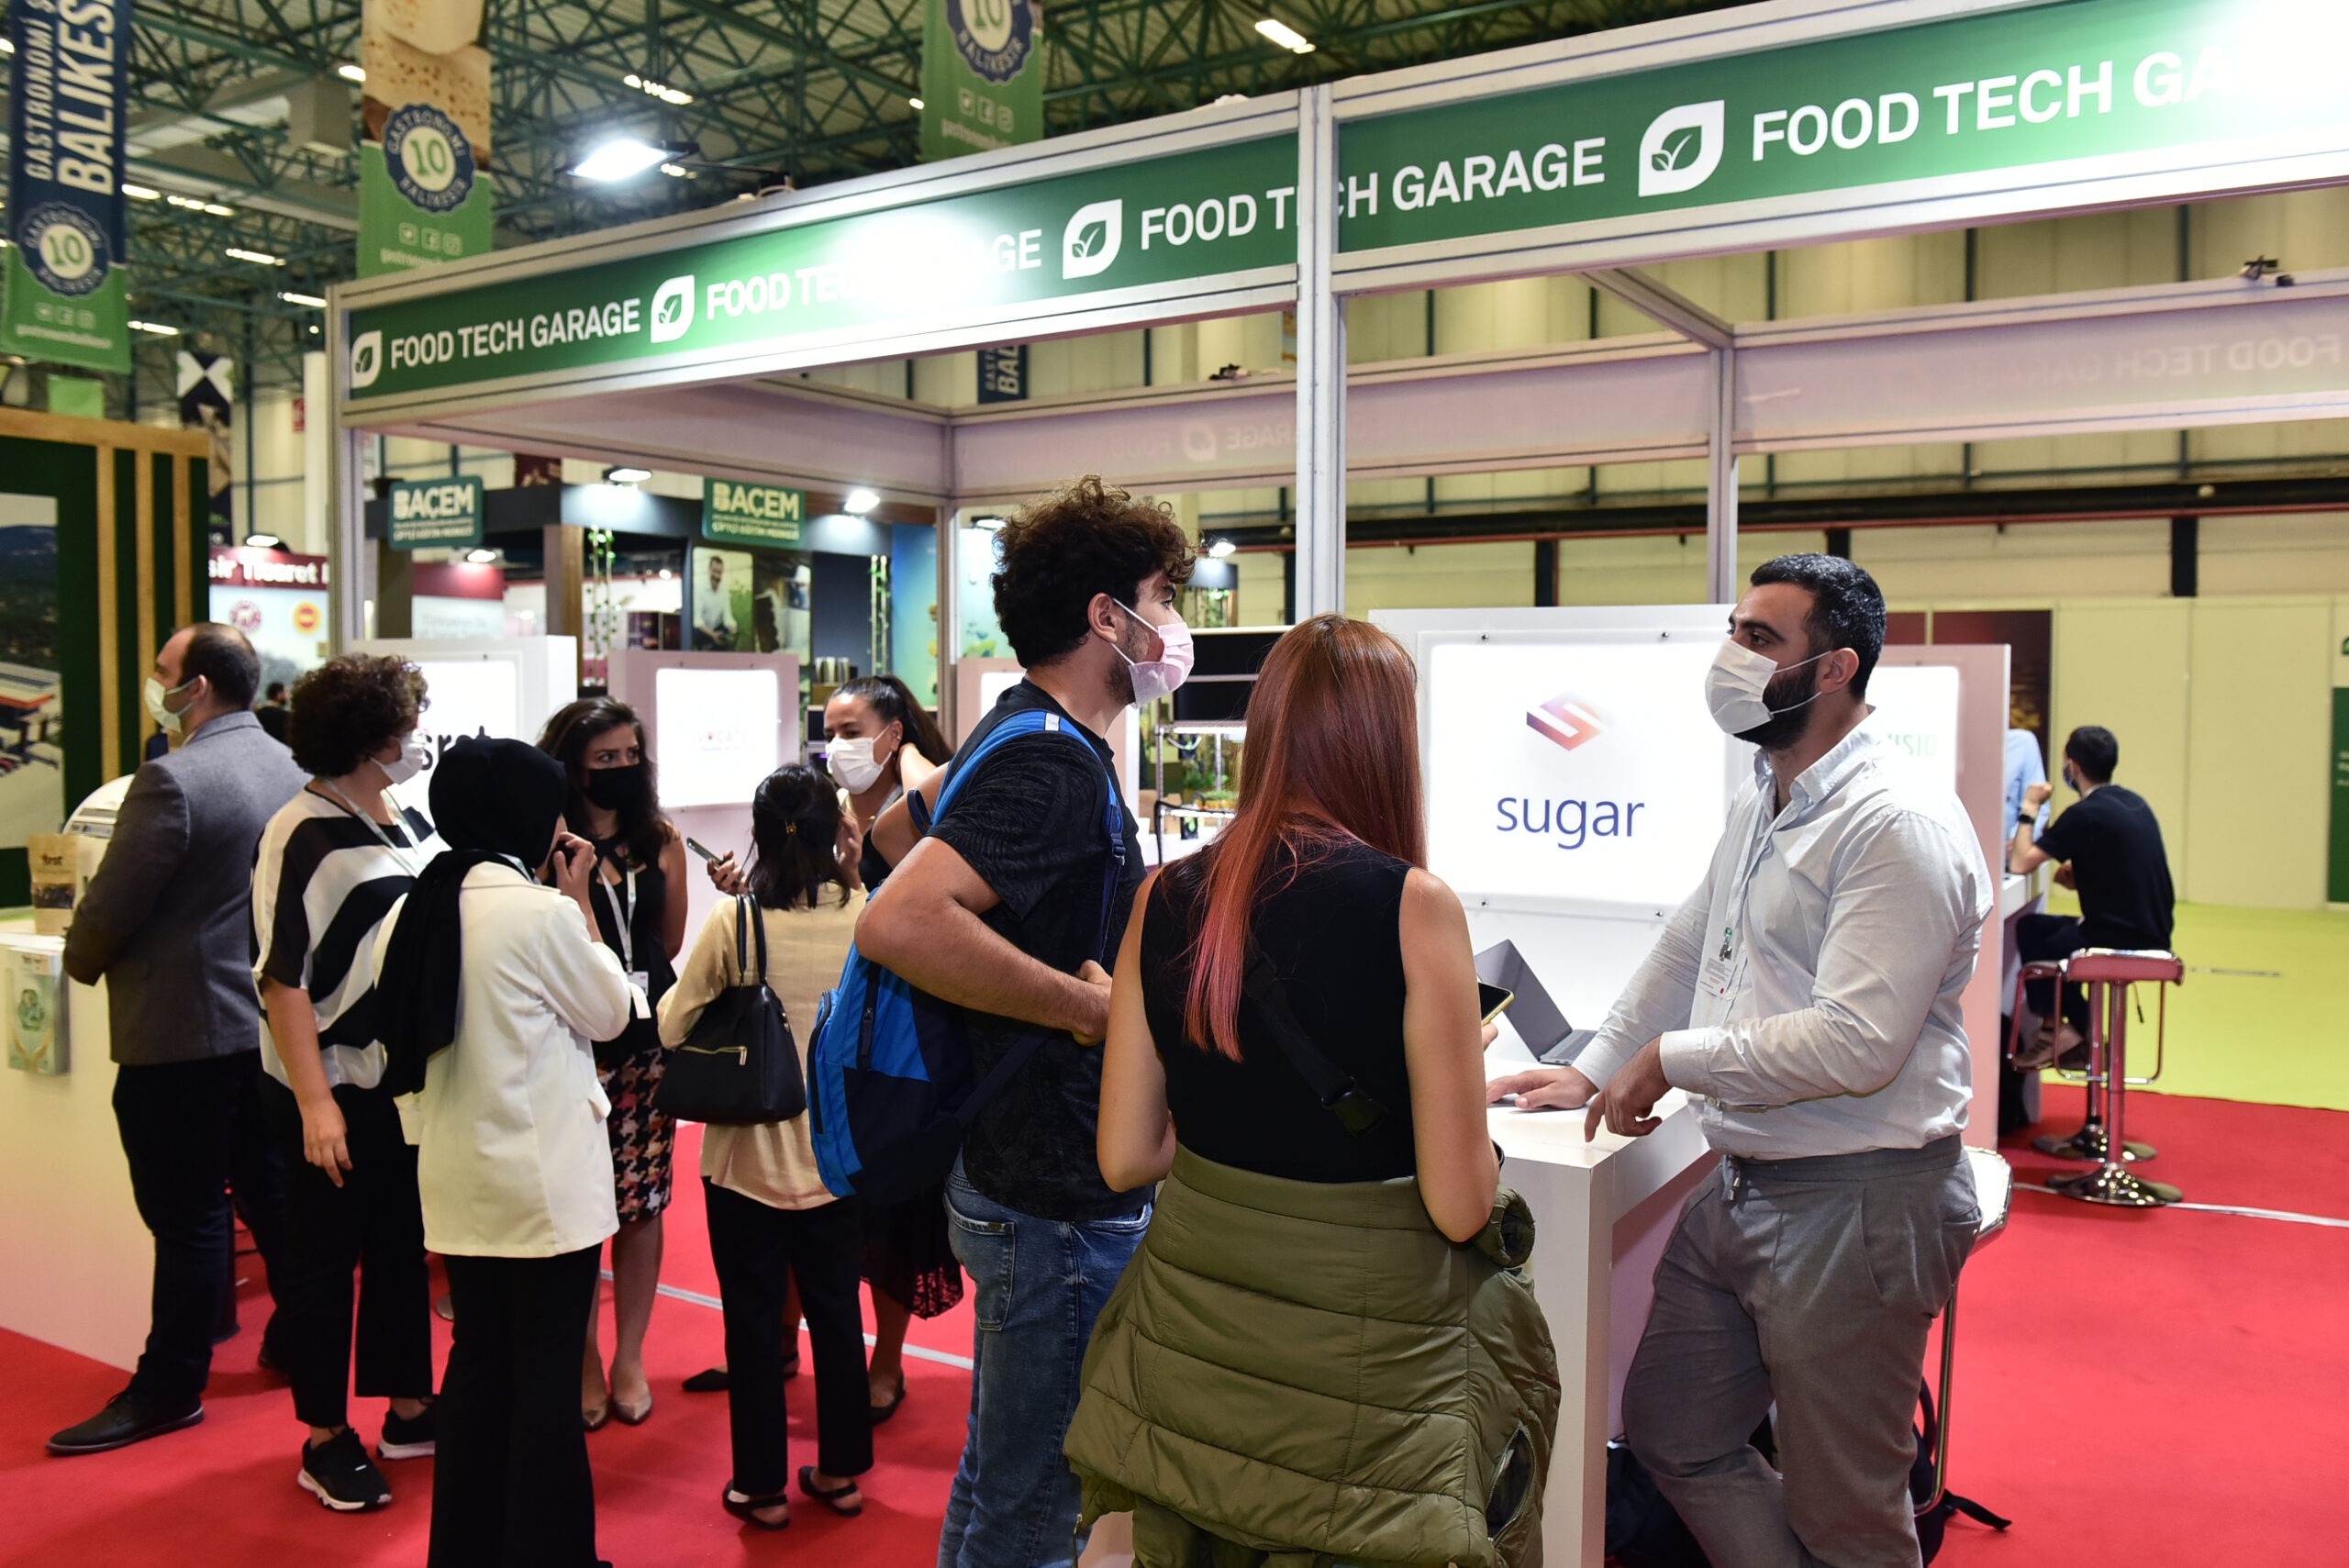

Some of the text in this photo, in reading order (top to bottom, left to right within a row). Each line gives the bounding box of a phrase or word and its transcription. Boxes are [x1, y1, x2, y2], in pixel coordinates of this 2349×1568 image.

[57, 0, 115, 195] BALIKES
[1753, 92, 1920, 161] FOOD
[1933, 61, 2112, 135] TECH
[409, 138, 448, 176] 10
[1141, 195, 1257, 250] FOOD
[1392, 137, 1606, 211] GARAGE
[49, 234, 84, 266] 10
[706, 272, 791, 320] FOOD
[390, 297, 640, 370] FOOD TECH GARAGE
[394, 484, 474, 520] BAÇEM
[713, 482, 799, 521] BAÇEM
[1497, 796, 1645, 851] sugar
